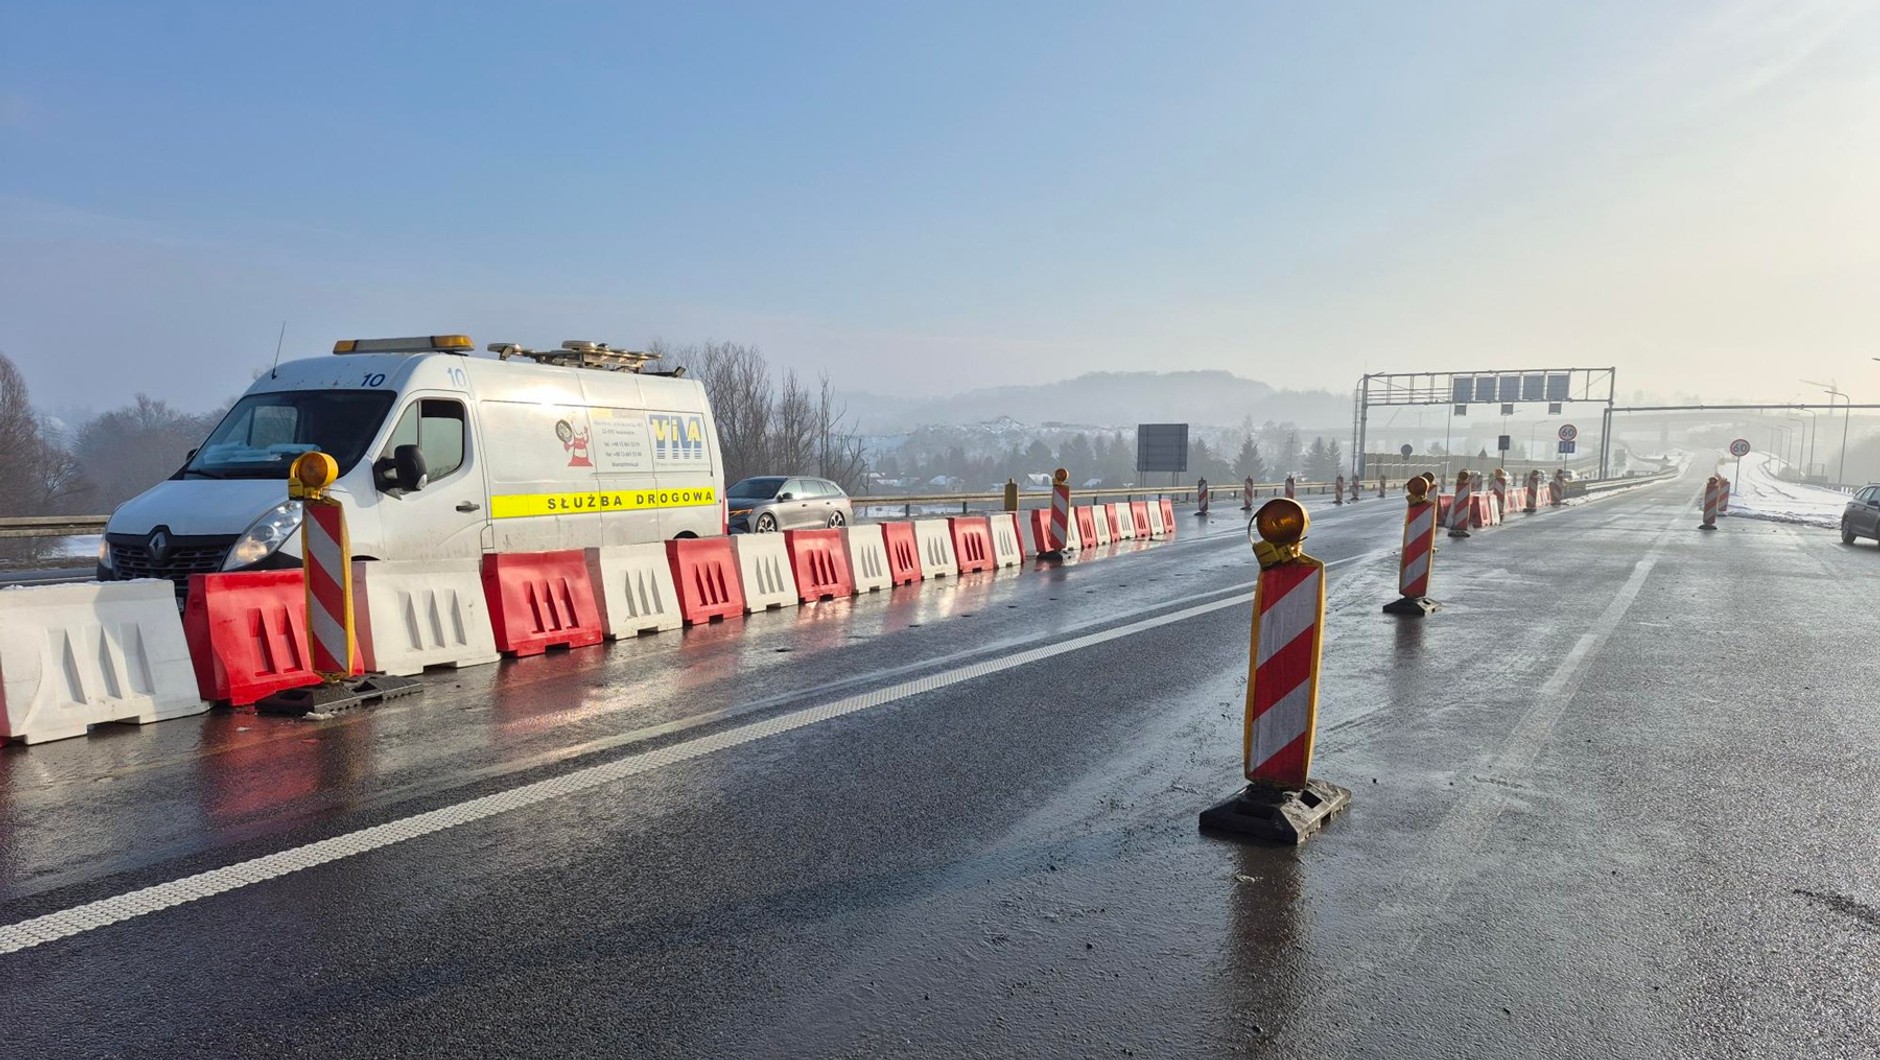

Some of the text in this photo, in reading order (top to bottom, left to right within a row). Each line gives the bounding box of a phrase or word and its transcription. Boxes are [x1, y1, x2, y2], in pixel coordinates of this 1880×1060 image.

[361, 373, 386, 387] 10
[447, 367, 467, 387] 10
[1562, 428, 1574, 437] 60
[1733, 443, 1747, 452] 60
[547, 491, 713, 510] SŁUŻBA DROGOWA
